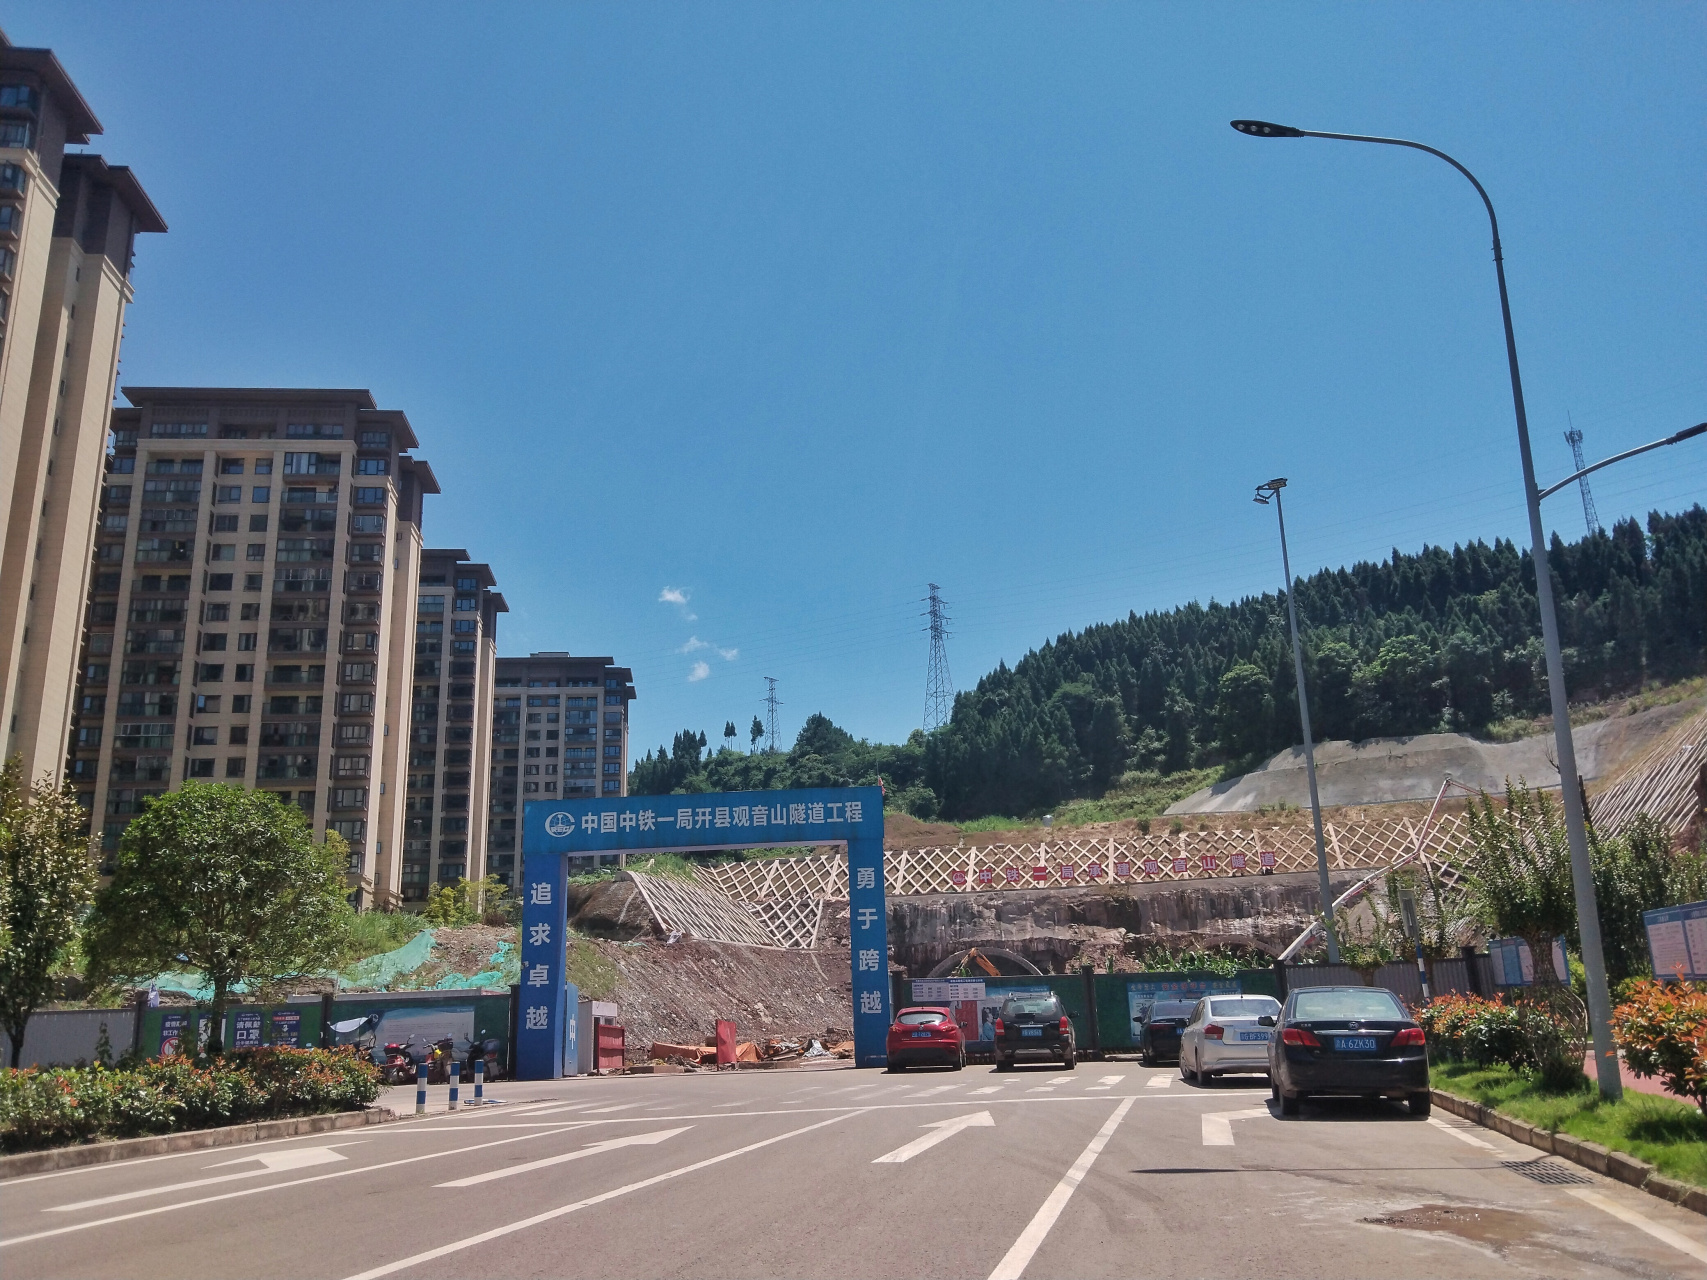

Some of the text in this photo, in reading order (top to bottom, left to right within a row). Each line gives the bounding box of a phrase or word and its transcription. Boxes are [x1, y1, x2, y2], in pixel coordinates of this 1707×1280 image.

[581, 801, 863, 835] 中国中铁一局开县观音山隧道工程
[978, 852, 1276, 883] 中铁一局承建观音山隧道
[525, 882, 552, 1031] 追求卓越
[856, 867, 882, 1015] 勇于跨越
[236, 1020, 261, 1029] 请佩戴
[236, 1029, 260, 1040] 口罩
